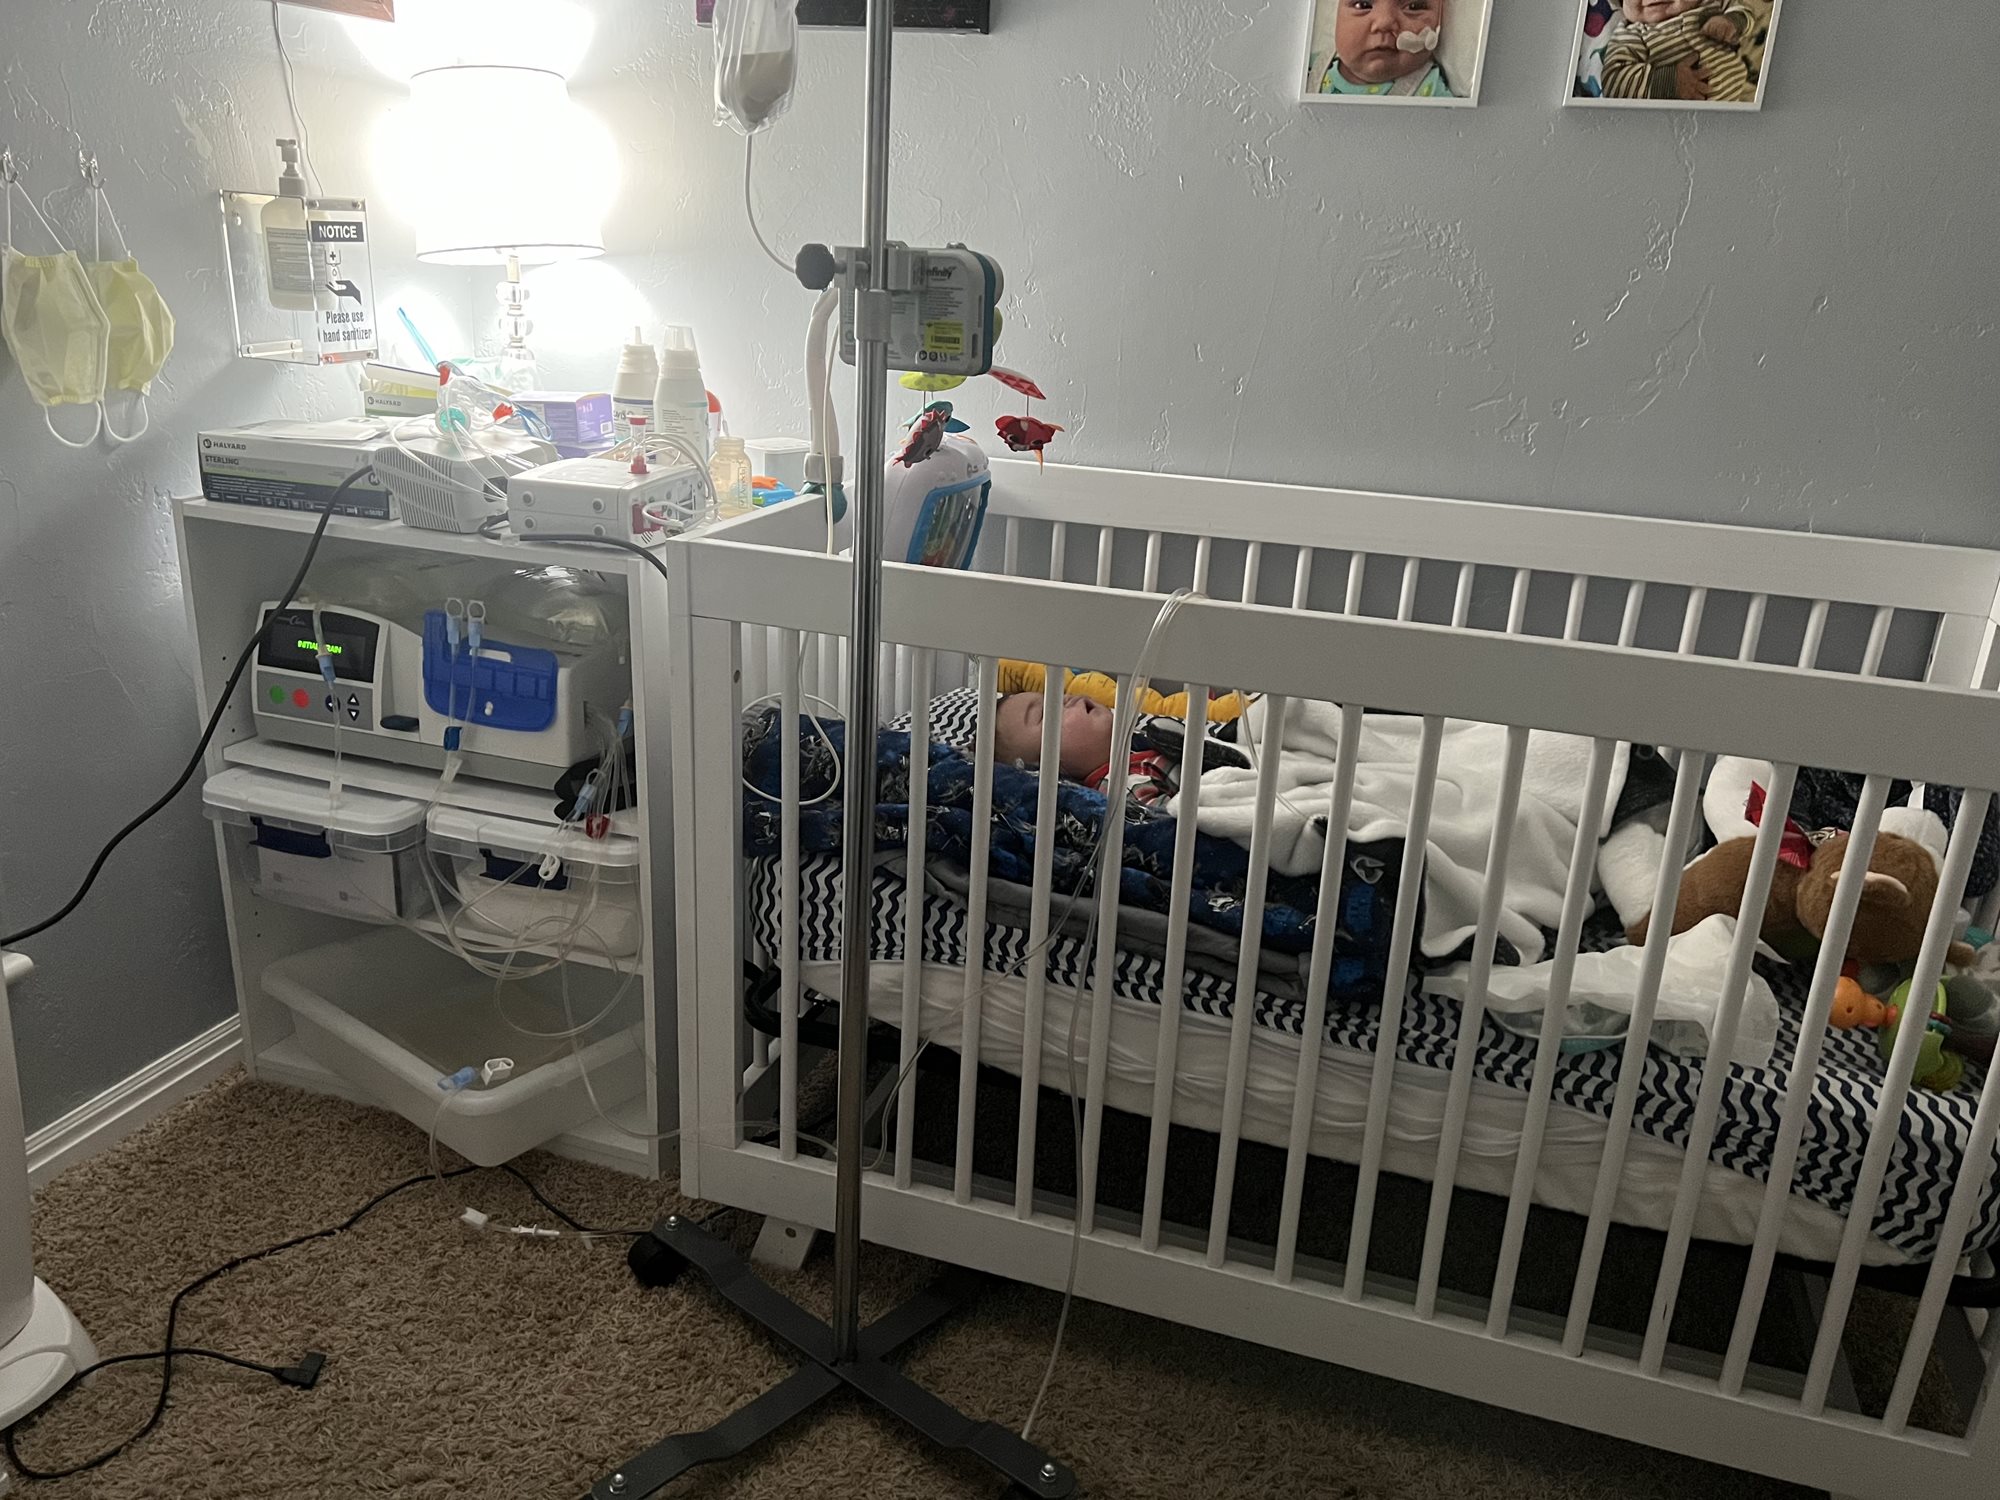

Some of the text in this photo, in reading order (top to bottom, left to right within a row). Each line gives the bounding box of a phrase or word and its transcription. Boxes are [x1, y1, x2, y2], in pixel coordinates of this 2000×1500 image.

[318, 225, 358, 238] NOTICE
[325, 311, 365, 324] Please use
[322, 327, 373, 342] hand sanitizer
[375, 399, 402, 407] HALYARD
[213, 441, 247, 450] HALYARD
[205, 455, 239, 465] STERLING
